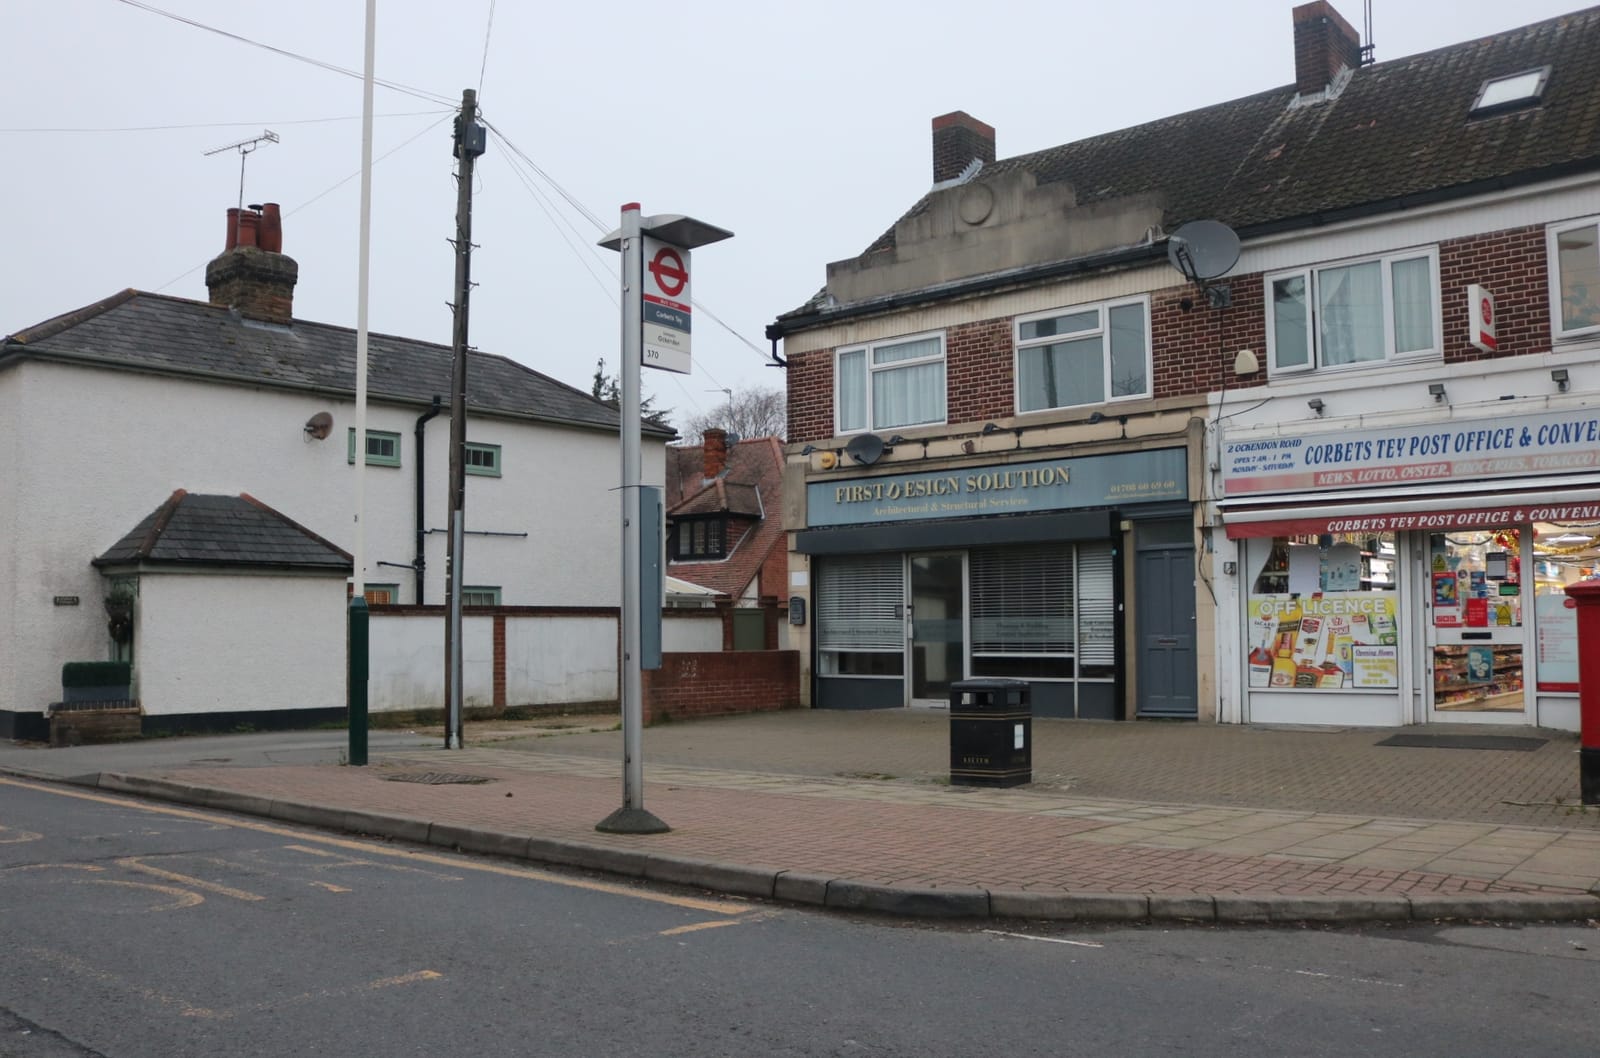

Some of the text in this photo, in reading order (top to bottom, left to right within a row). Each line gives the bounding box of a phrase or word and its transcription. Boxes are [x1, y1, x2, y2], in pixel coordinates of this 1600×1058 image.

[647, 349, 660, 359] 370
[1227, 439, 1302, 453] 2 OCKENDON ROAD
[1305, 420, 1600, 465] CORBETS TEY POST OFFICE & CONVE
[836, 483, 884, 504] FIRST
[966, 466, 1071, 493] SOLUTION
[873, 497, 1029, 516] Architectural & Structural Services
[1327, 505, 1600, 532] CORBETS TEY POST OFFICE & CONVENI
[1260, 599, 1386, 616] OFF LICENCE
